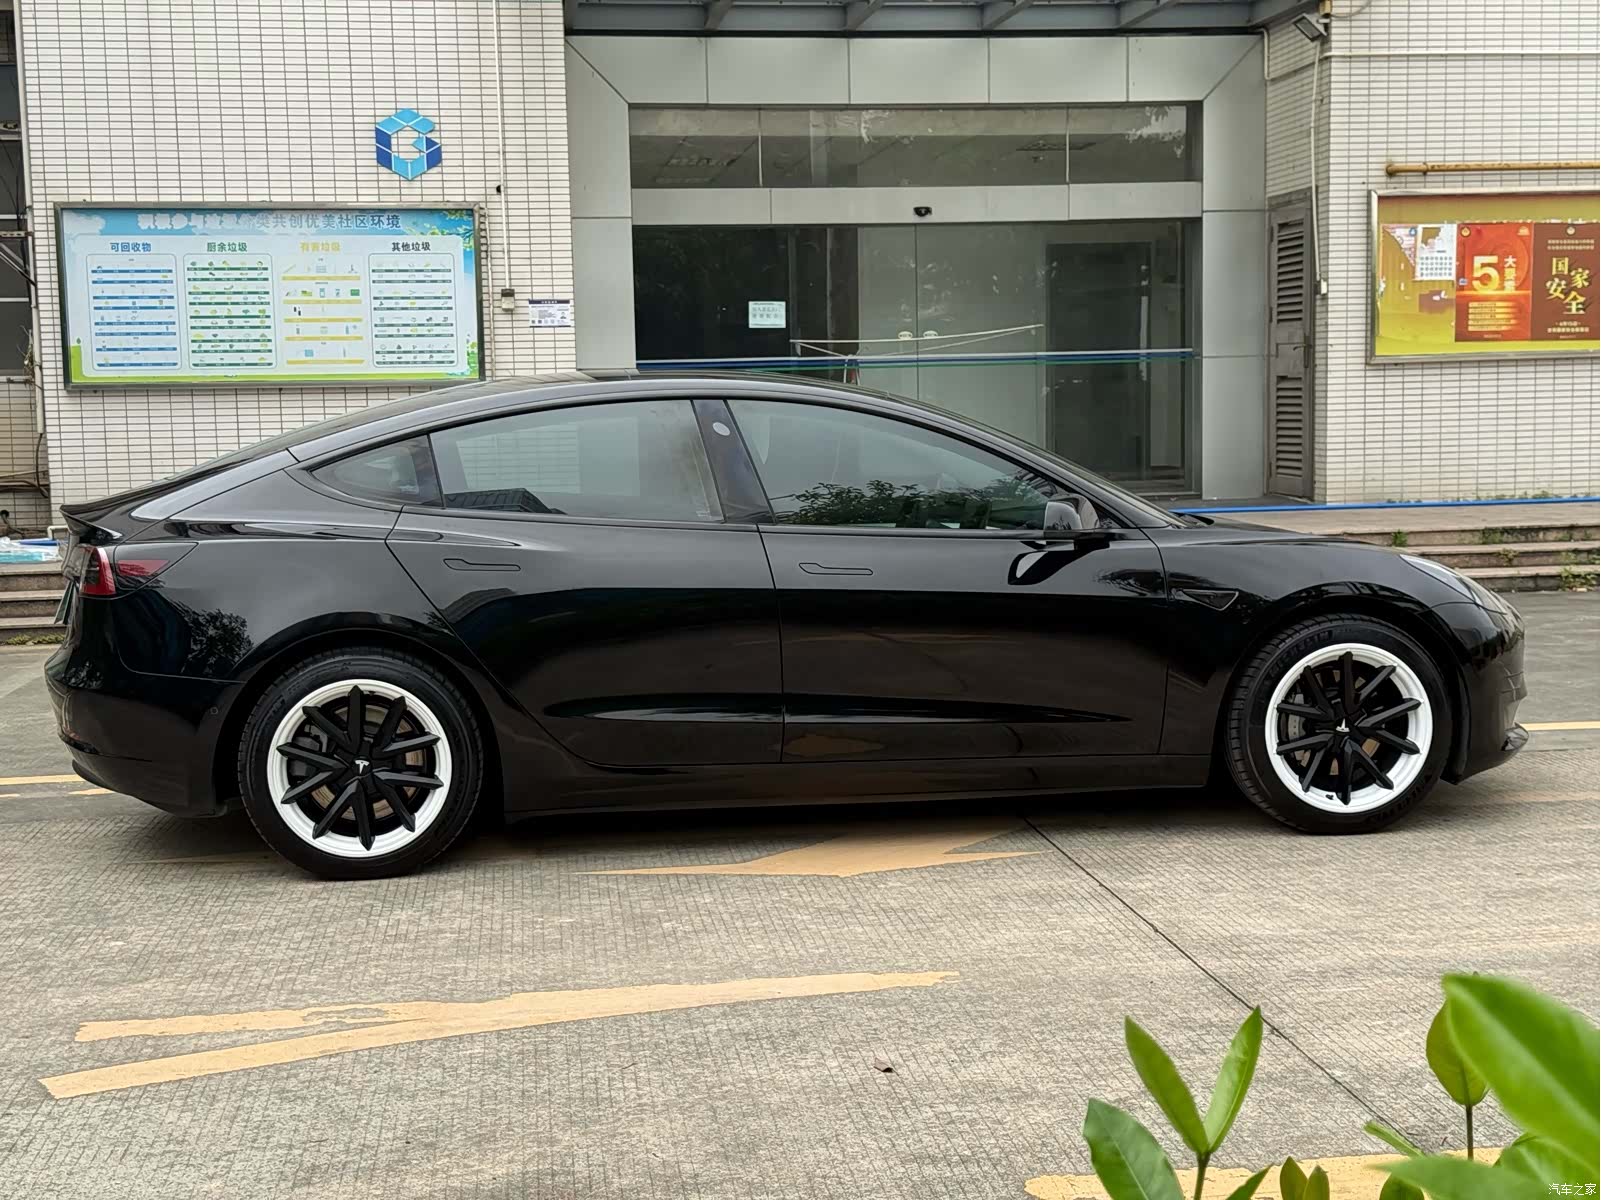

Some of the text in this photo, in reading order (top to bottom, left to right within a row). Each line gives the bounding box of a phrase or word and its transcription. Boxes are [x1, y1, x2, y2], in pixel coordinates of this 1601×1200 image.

[137, 213, 401, 229] 类共创优美社区环境
[110, 242, 151, 252] 可回收物
[207, 242, 247, 252] 厨余垃圾
[392, 241, 431, 252] 其他垃圾
